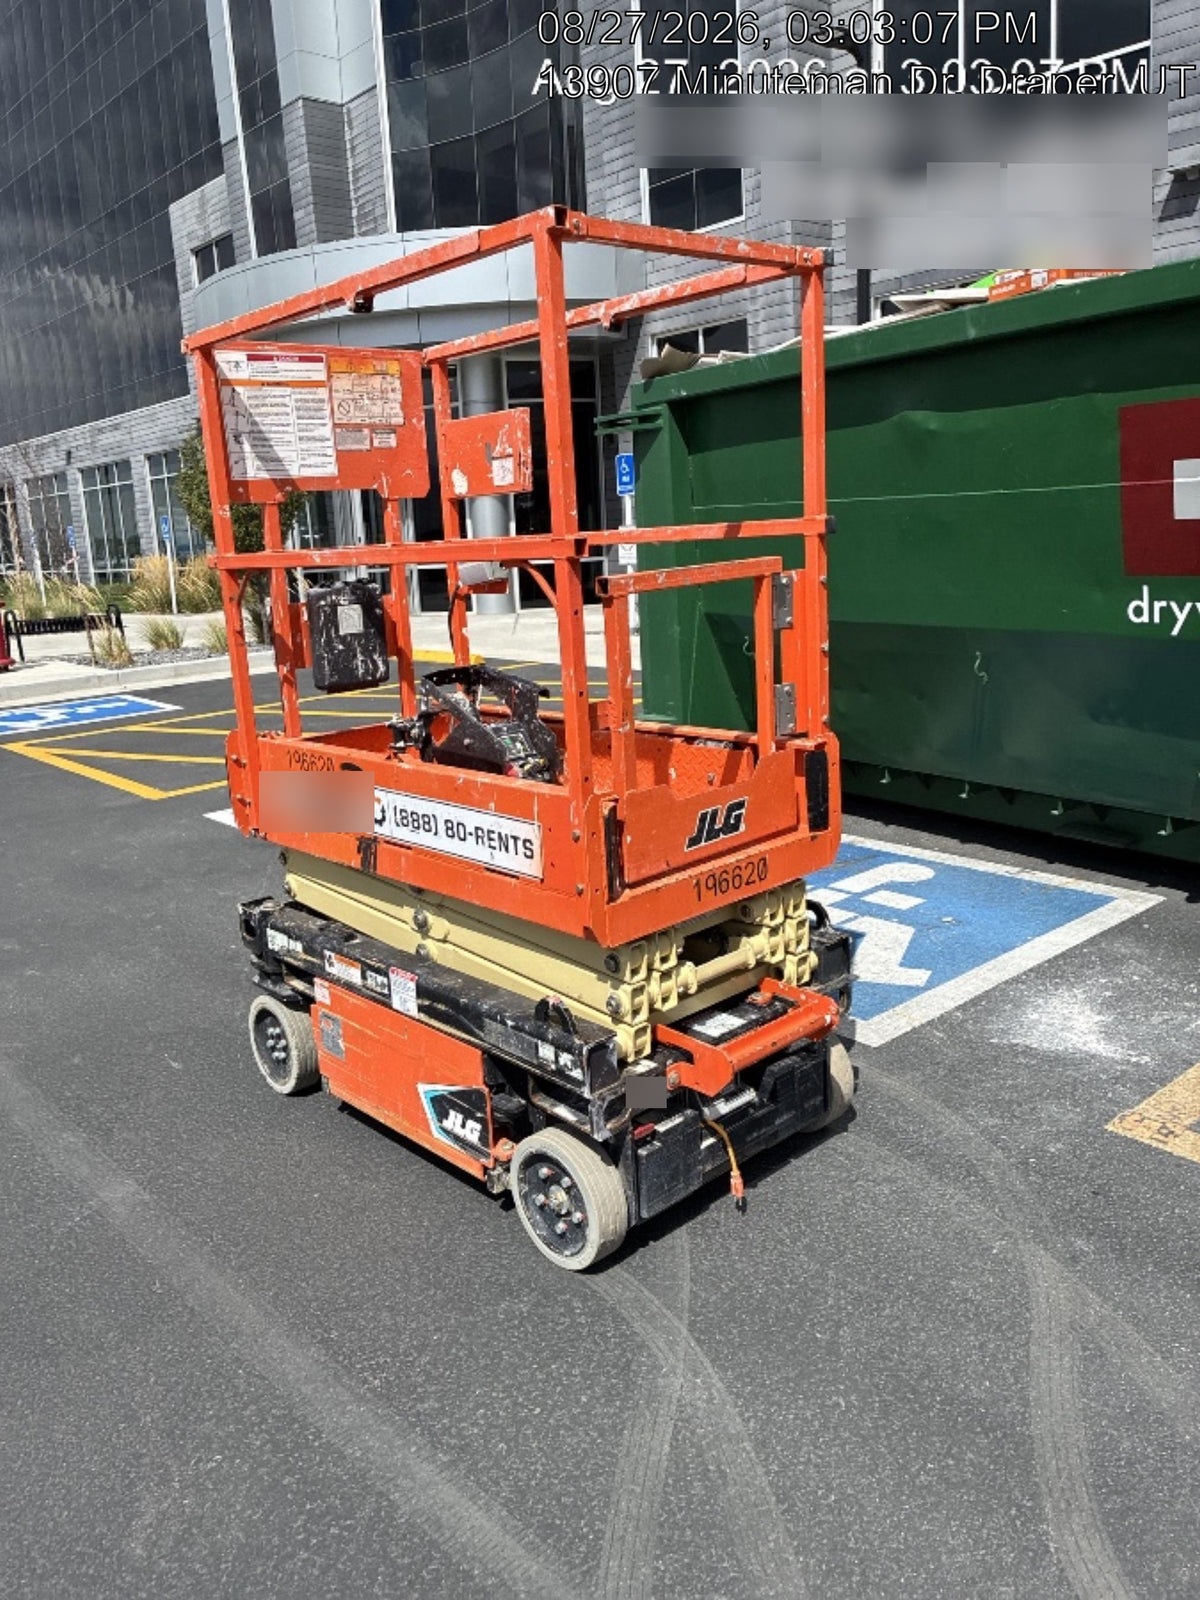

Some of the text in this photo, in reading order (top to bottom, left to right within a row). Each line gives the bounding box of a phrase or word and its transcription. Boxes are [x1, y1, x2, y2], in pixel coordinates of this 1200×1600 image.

[1127, 584, 1200, 636] dry
[393, 805, 535, 860] (888) 80-RENTS
[684, 796, 748, 852] JLG
[693, 855, 768, 902] 196620
[442, 1109, 482, 1145] JLG
